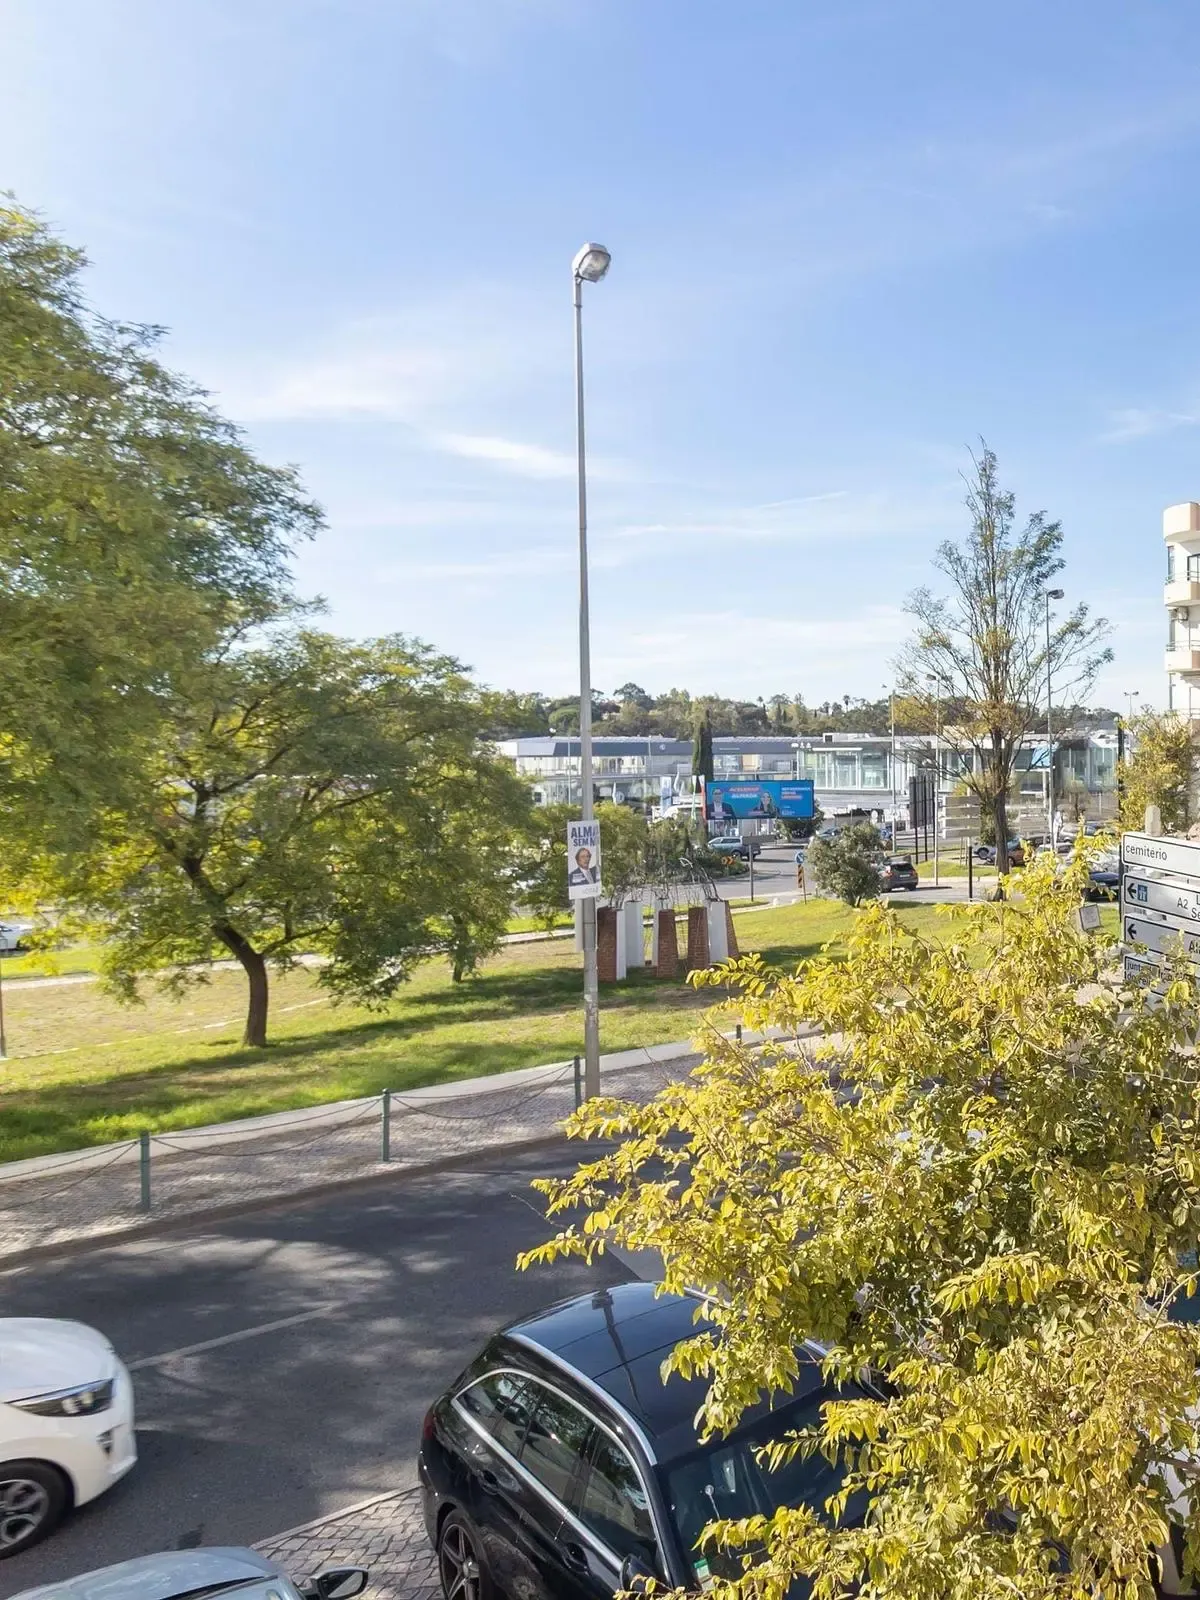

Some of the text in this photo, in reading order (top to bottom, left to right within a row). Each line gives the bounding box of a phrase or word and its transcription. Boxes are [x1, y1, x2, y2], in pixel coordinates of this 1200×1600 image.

[573, 838, 588, 847] SEM
[1125, 844, 1167, 861] cemitério
[1177, 897, 1189, 910] A2
